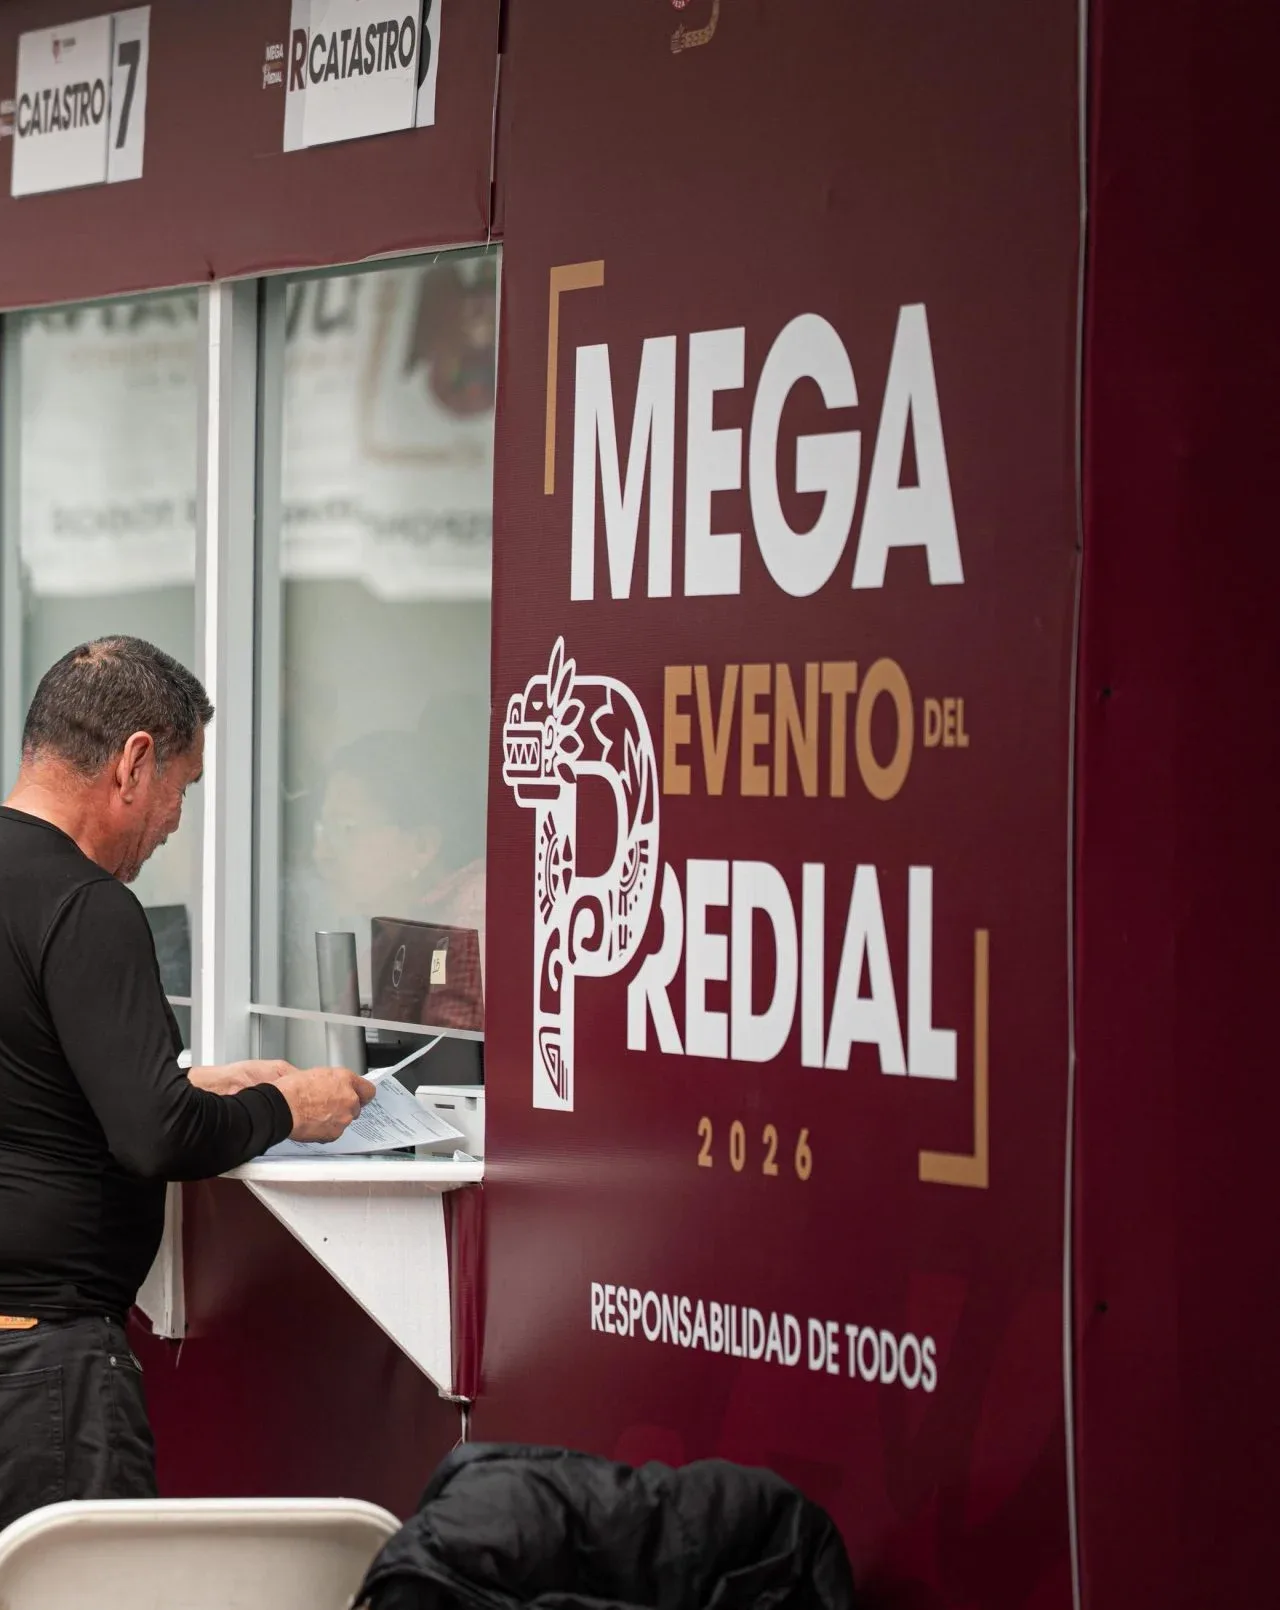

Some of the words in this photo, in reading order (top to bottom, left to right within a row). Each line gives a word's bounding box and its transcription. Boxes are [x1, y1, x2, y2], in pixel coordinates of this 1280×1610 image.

[17, 78, 106, 138] CATASTRO
[116, 40, 141, 149] 7
[309, 15, 416, 84] CATASTRO
[571, 303, 964, 601] MEGA
[663, 657, 914, 800] EVENTO
[923, 697, 969, 748] DEL
[698, 1116, 813, 1181] 2026
[591, 1281, 802, 1367] RESPONSABILIDAD
[808, 1317, 839, 1375] DE
[845, 1324, 938, 1393] TODOS
